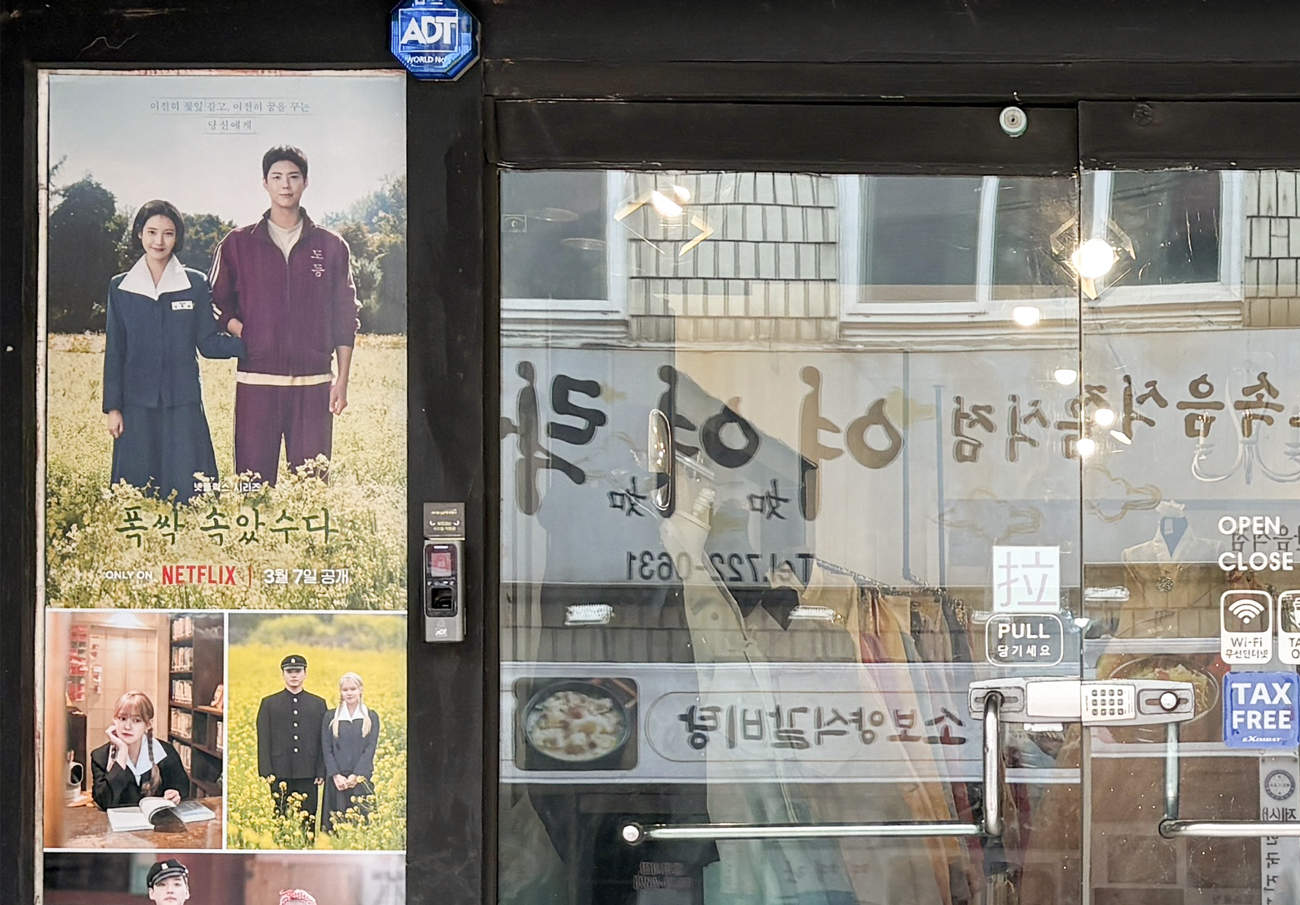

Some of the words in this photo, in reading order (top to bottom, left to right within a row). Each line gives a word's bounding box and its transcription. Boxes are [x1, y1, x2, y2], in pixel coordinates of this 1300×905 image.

[400, 16, 457, 45] ADT
[406, 55, 433, 64] WORLD
[115, 505, 186, 548] 폭싹
[199, 506, 340, 547] 속았수다
[1217, 515, 1281, 535] OPEN
[1217, 551, 1295, 571] CLOSE
[104, 570, 134, 581] ONLY
[136, 570, 153, 580] ON
[162, 564, 236, 585] NETFLIX
[263, 568, 289, 585] 3월
[293, 568, 317, 585] 7일
[320, 568, 350, 585] 공개
[997, 551, 1058, 608] 拉
[998, 622, 1051, 639] PULL
[997, 644, 1051, 658] 당기세요
[1230, 637, 1263, 648] Wi-Fi
[1231, 682, 1292, 705] TAX
[1231, 709, 1292, 730] FREE
